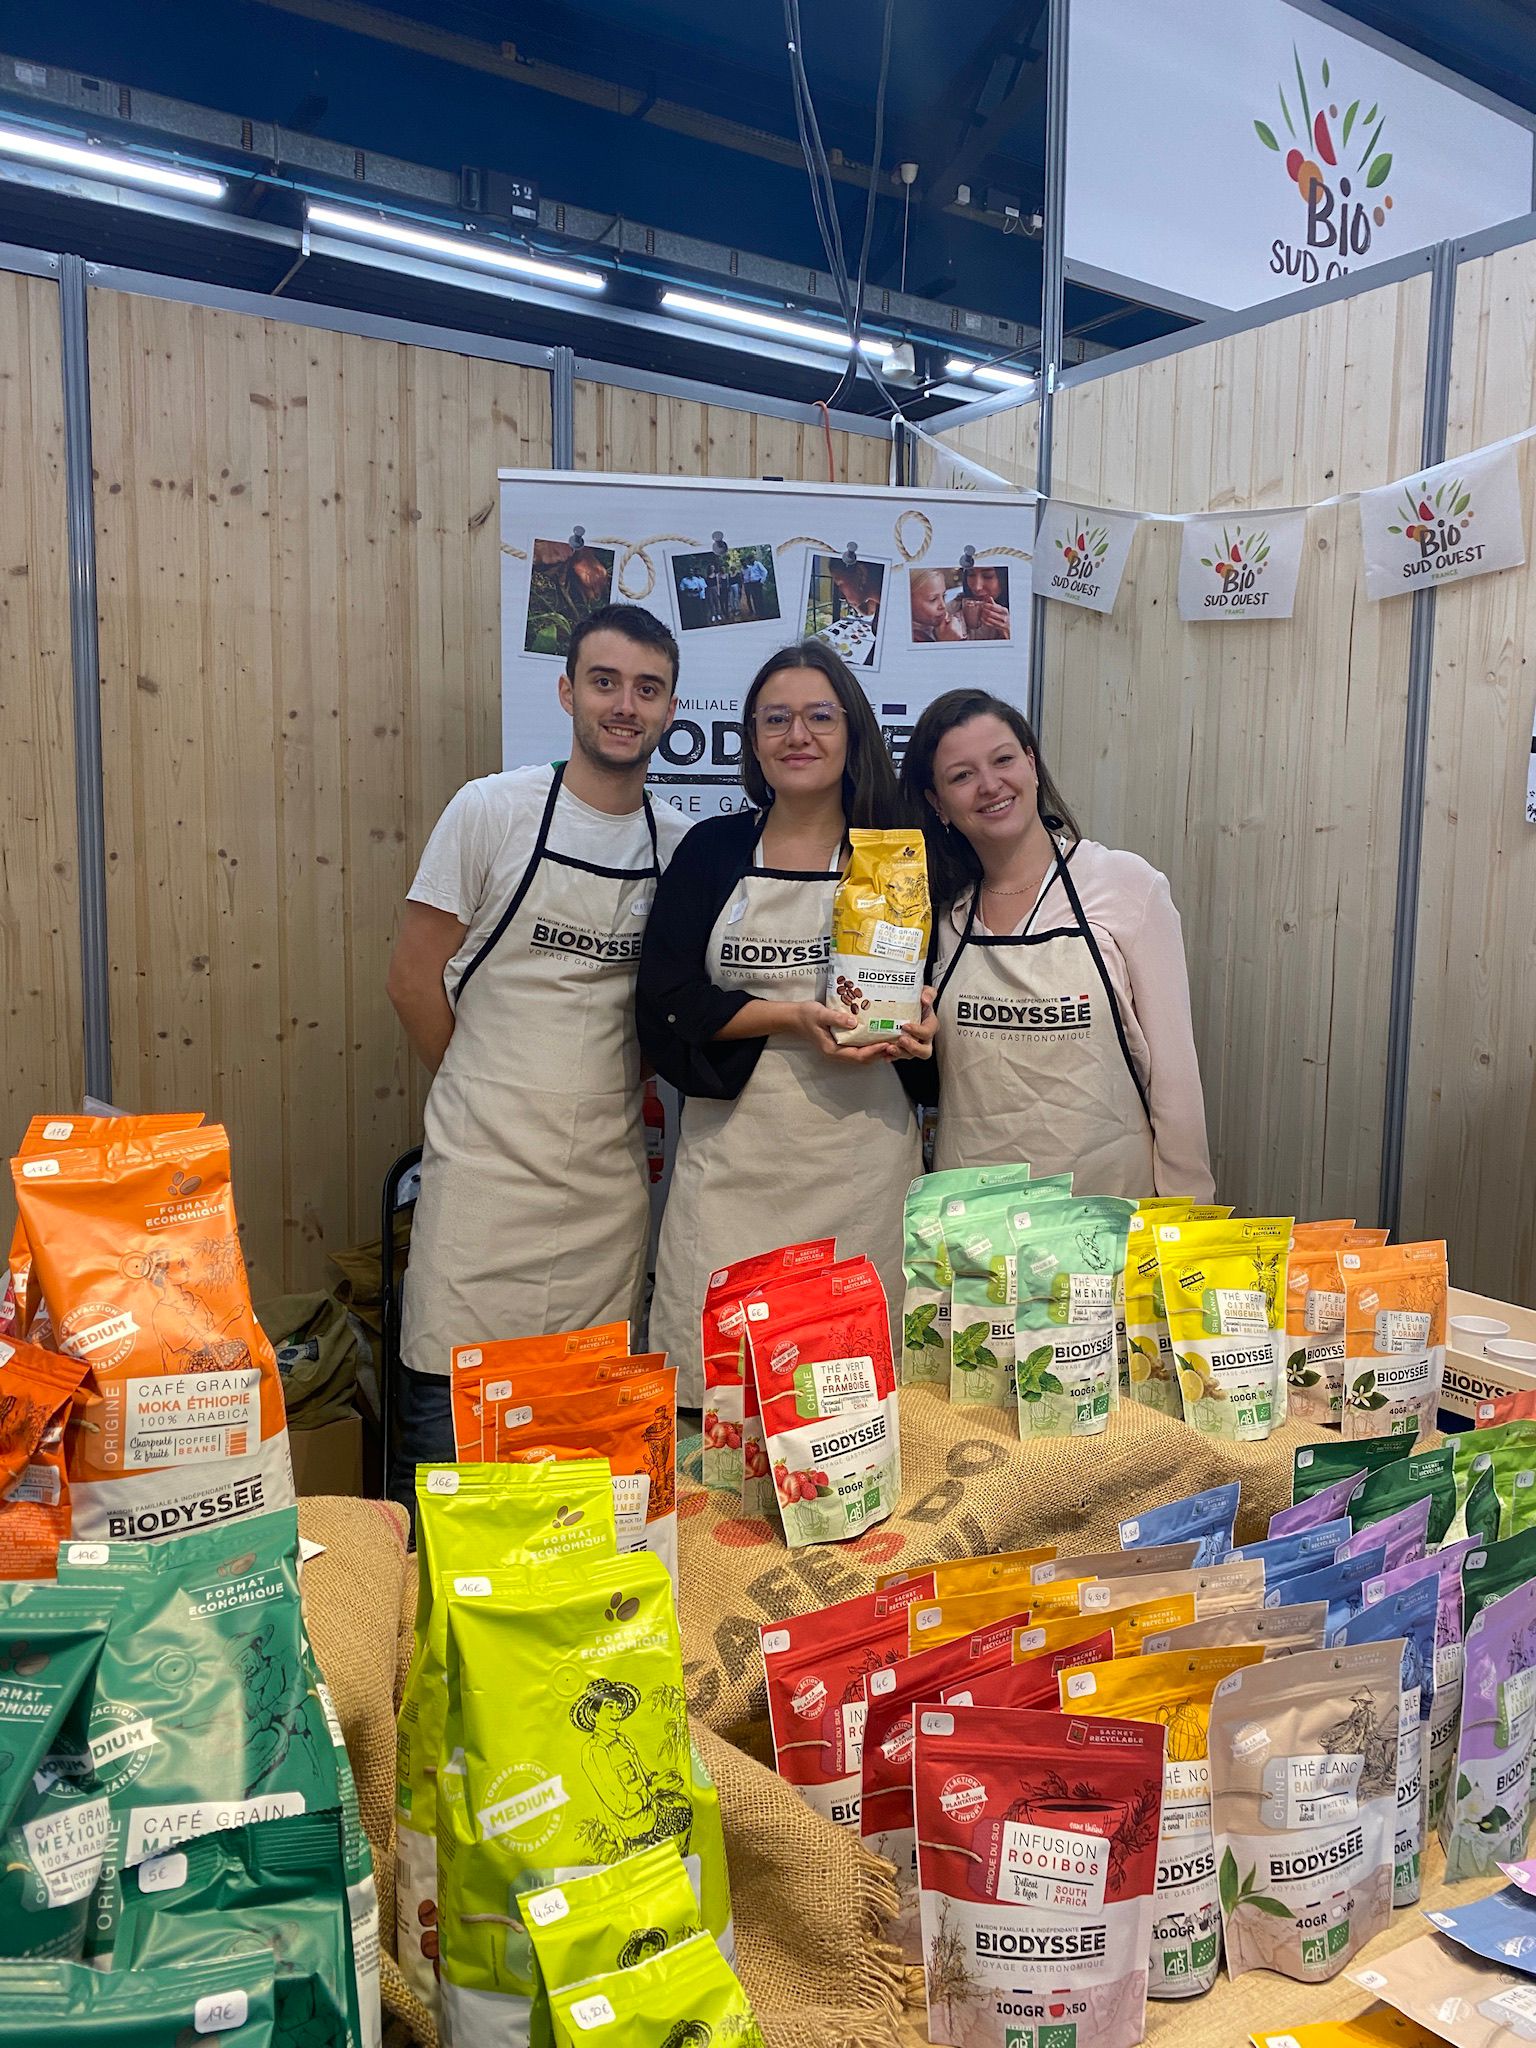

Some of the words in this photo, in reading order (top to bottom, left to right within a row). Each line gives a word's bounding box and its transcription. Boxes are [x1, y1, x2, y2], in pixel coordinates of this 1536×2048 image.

[1307, 177, 1371, 256] Bio
[1269, 239, 1319, 283] SUD
[1420, 519, 1461, 558] Bio
[1066, 554, 1093, 579] Bio
[1403, 560, 1432, 578] SUD
[1436, 544, 1486, 569] OUEST
[1222, 563, 1255, 593] Bio
[1431, 569, 1458, 580] FRANCE
[1051, 575, 1069, 590] SUD
[1071, 580, 1100, 597] OUEST
[1204, 594, 1228, 607] SUD
[1231, 592, 1270, 606] OUEST
[1224, 608, 1246, 616] FRANCE
[678, 699, 738, 711] MILIALE
[533, 923, 641, 957] BIODYSSE
[528, 948, 570, 962] VOYAGE
[721, 943, 830, 963] BIODYSS
[720, 969, 759, 979] VOYAGE
[981, 995, 1008, 1003] FAMILIALE
[957, 1029, 995, 1040] VOYAGE
[1000, 1030, 1091, 1042] GASTRONOMIQUE
[159, 1199, 209, 1215] FORMAT
[145, 1204, 226, 1227] ECONOMIQUE
[997, 1265, 1005, 1299] CHINE
[1072, 1276, 1090, 1287] THÉ
[1058, 1282, 1069, 1318] CHINE
[1210, 1290, 1218, 1315] LANKA
[1223, 1291, 1240, 1300] THÉ
[1318, 1293, 1331, 1301] THÉ
[751, 1308, 763, 1317] 6€
[1227, 1301, 1260, 1311] CITRON
[1324, 1303, 1345, 1311] FLEU
[1225, 1310, 1263, 1318] GINGEMBRE
[1389, 1312, 1403, 1321] THÉ
[1405, 1314, 1429, 1323] BLANC
[1396, 1323, 1423, 1331] FLEUR
[67, 1320, 127, 1354] MEDIUM
[1391, 1330, 1425, 1339] D'ORANGER
[462, 1355, 475, 1364] 7€
[821, 1363, 841, 1374] THÉ
[846, 1361, 865, 1371] VERT
[826, 1371, 864, 1384] FRAISE
[138, 1379, 185, 1398] CAFÉ
[196, 1377, 250, 1392] GRAIN
[494, 1387, 507, 1396] 7€
[803, 1371, 816, 1411] CHINE
[822, 1380, 870, 1394] FRAMBOISE
[1070, 1386, 1096, 1397] 100GR
[138, 1400, 181, 1414] MOKA
[187, 1392, 250, 1410] ÉTHIOPIE
[1230, 1392, 1257, 1403] 100GR
[1440, 1390, 1469, 1405] VOYAGE
[853, 1402, 868, 1410] CHINA
[1389, 1405, 1407, 1415] 40GR
[140, 1415, 177, 1427] 100%
[187, 1408, 249, 1423] ARABICA
[515, 1411, 528, 1422] 7€
[104, 1386, 120, 1464] ORIGINE
[130, 1434, 173, 1450] Charpenté
[179, 1434, 217, 1446] COFFEE
[144, 1448, 170, 1462] fruité
[179, 1445, 216, 1455] BEANS
[838, 1481, 864, 1496] 80GR
[106, 1508, 133, 1516] MAISON
[135, 1499, 172, 1513] FAMILIALE
[181, 1483, 232, 1502] INDÉPENDANTE
[543, 1528, 593, 1546] FORMAT
[530, 1534, 607, 1562] ECONOMIQUE
[73, 1551, 99, 1560] 19€
[206, 1576, 266, 1601] FORMAT
[188, 1582, 284, 1616] ECONOMIQUE
[888, 1594, 924, 1612] RECYCLABLE
[894, 1590, 917, 1603] SACHET
[921, 1615, 933, 1625] 5€
[595, 1626, 652, 1645] FORMAT
[768, 1636, 780, 1648] 4€
[988, 1629, 1010, 1643] SACHET
[1026, 1636, 1037, 1645] 5€
[581, 1632, 669, 1661] ECONOMIQUE
[876, 1678, 889, 1690] 4€
[1074, 1681, 1087, 1691] 5€
[0, 1688, 43, 1702] RMAT
[796, 1690, 824, 1710] PLANTATION
[926, 1717, 941, 1730] 4€
[836, 1727, 842, 1737] DU
[1100, 1729, 1135, 1737] SACHET
[1089, 1735, 1144, 1744] RECYCLABLE
[1166, 1764, 1182, 1783] HÉ
[1292, 1761, 1316, 1777] THÉ
[1320, 1762, 1358, 1775] BLANC
[945, 1794, 983, 1809] PLANTATION
[961, 1791, 971, 1799] LA
[1273, 1770, 1285, 1820] CHINE
[489, 1787, 556, 1829] MEDIUM
[957, 1805, 982, 1821] IMPORT
[1323, 1802, 1337, 1810] WHITE
[143, 1810, 203, 1835] CAFÉ
[215, 1804, 286, 1827] GRAIN
[34, 1816, 72, 1839] CAFÉ
[502, 1813, 561, 1852] ARTISANALE
[992, 1823, 1000, 1841] SUD
[990, 1844, 998, 1857] DU
[1013, 1832, 1097, 1860] INFUSION
[42, 1852, 70, 1868] 100%
[1008, 1850, 1098, 1876] ROOIBOS
[96, 1818, 121, 1931] ORIGINE
[148, 1868, 168, 1882] 5€
[985, 1859, 996, 1896] AFRIQUE
[1055, 1886, 1087, 1896] SOUTH
[1271, 1884, 1307, 1892] VOYAGE
[1053, 1896, 1087, 1907] AFRICA
[975, 1923, 998, 1931] MAISON
[1295, 1913, 1328, 1929] 40GR
[1153, 1926, 1195, 1940] 100GR
[975, 1959, 1016, 1971] VOYAGE
[1022, 1959, 1105, 1973] GASTRONOMIQUE
[205, 2002, 237, 2022] 19€
[996, 2002, 1044, 2018] 100GR
[1067, 2002, 1087, 2015] x50
